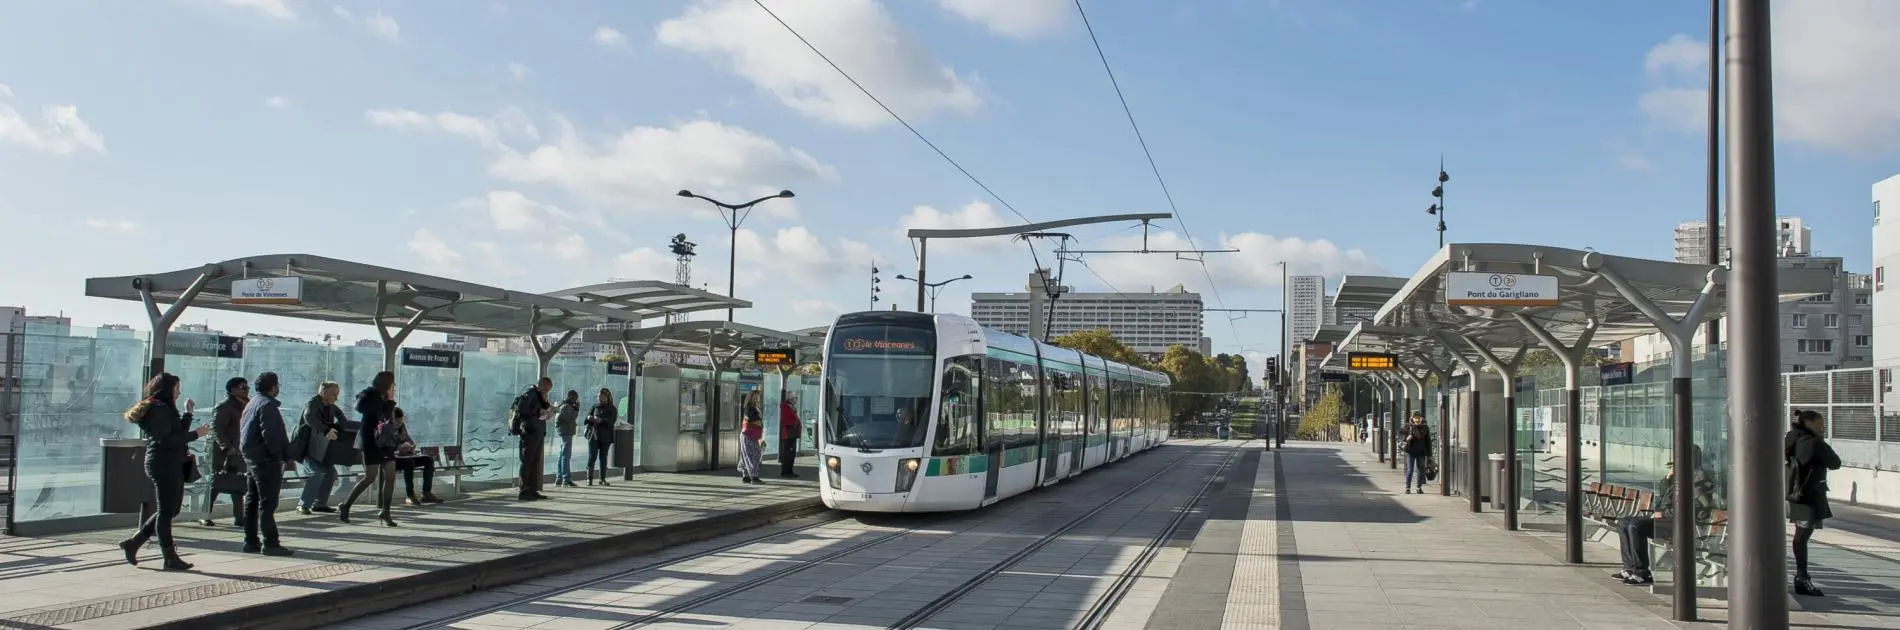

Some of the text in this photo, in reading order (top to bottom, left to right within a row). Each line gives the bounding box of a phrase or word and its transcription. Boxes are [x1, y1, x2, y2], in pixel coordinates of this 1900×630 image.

[1499, 290, 1539, 299] Garigliano
[202, 340, 226, 351] France
[874, 340, 914, 348] Vincennes
[410, 353, 426, 361] Avenue
[434, 354, 449, 363] France
